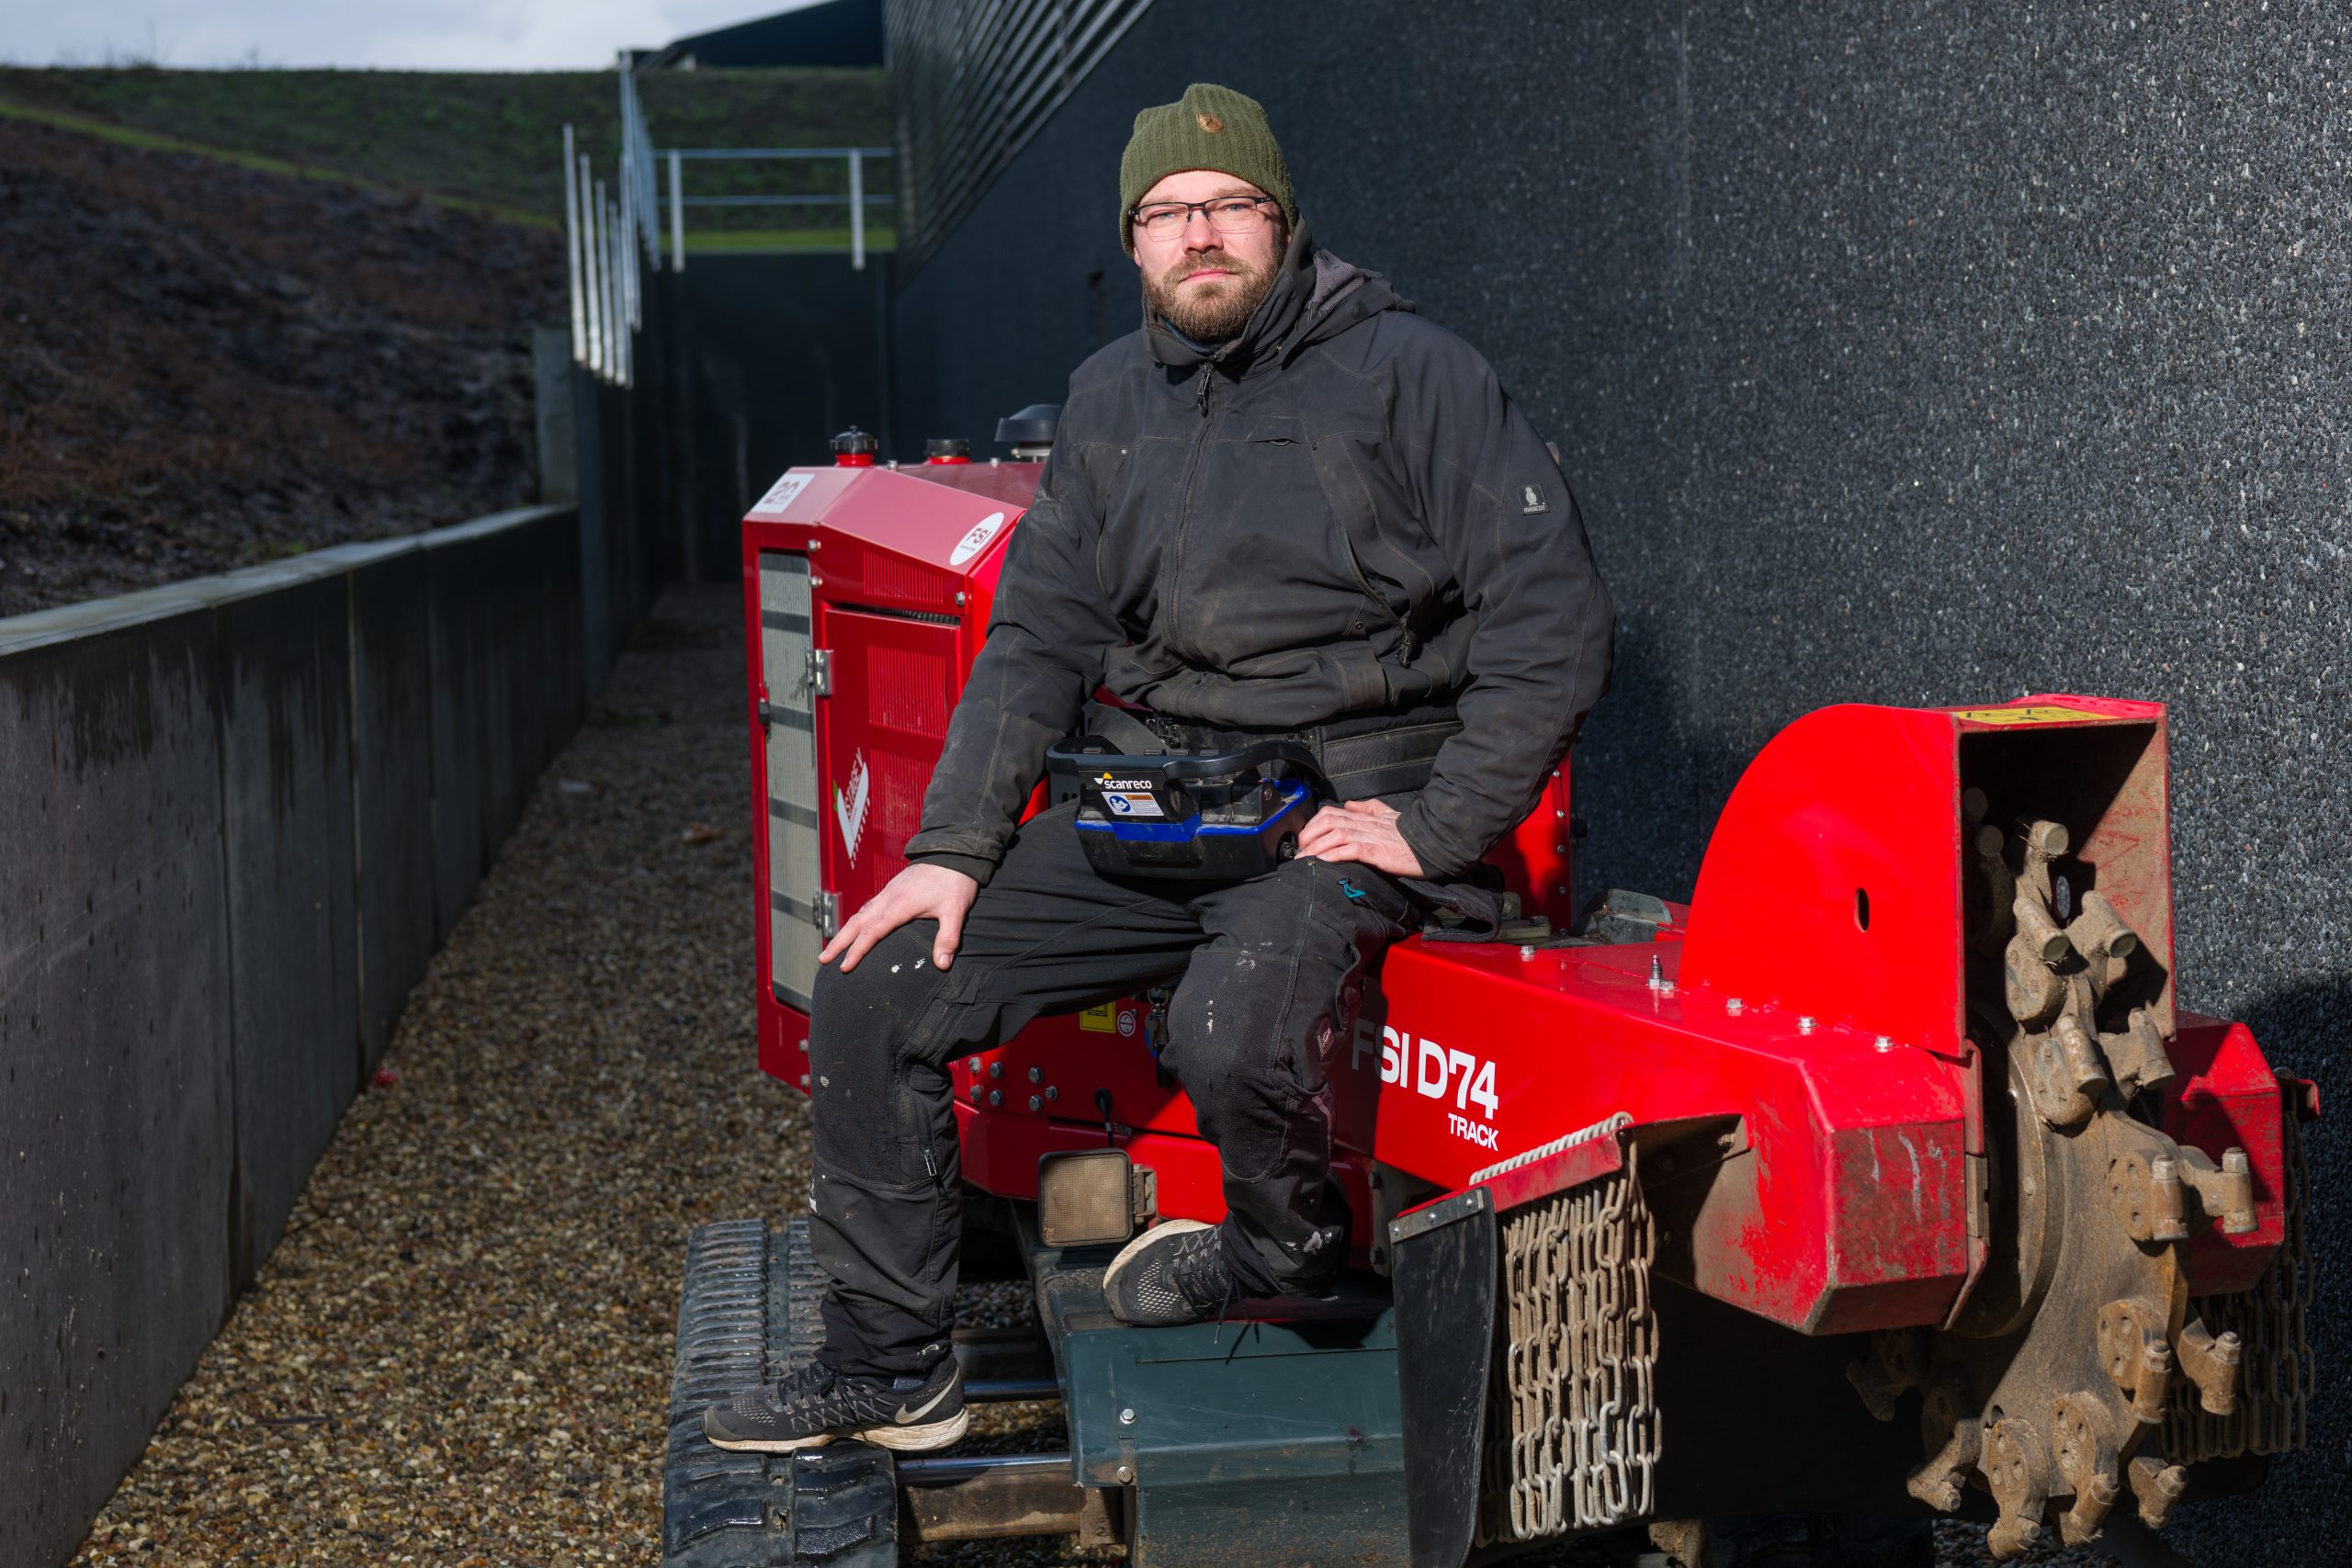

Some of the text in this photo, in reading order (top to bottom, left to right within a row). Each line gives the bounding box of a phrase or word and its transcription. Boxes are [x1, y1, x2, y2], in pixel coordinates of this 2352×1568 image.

[1523, 504, 1545, 513] MASCOT
[1103, 780, 1152, 790] scanreco
[1351, 1018, 1499, 1120] FSI D74
[1448, 1112, 1499, 1151] TRACK
